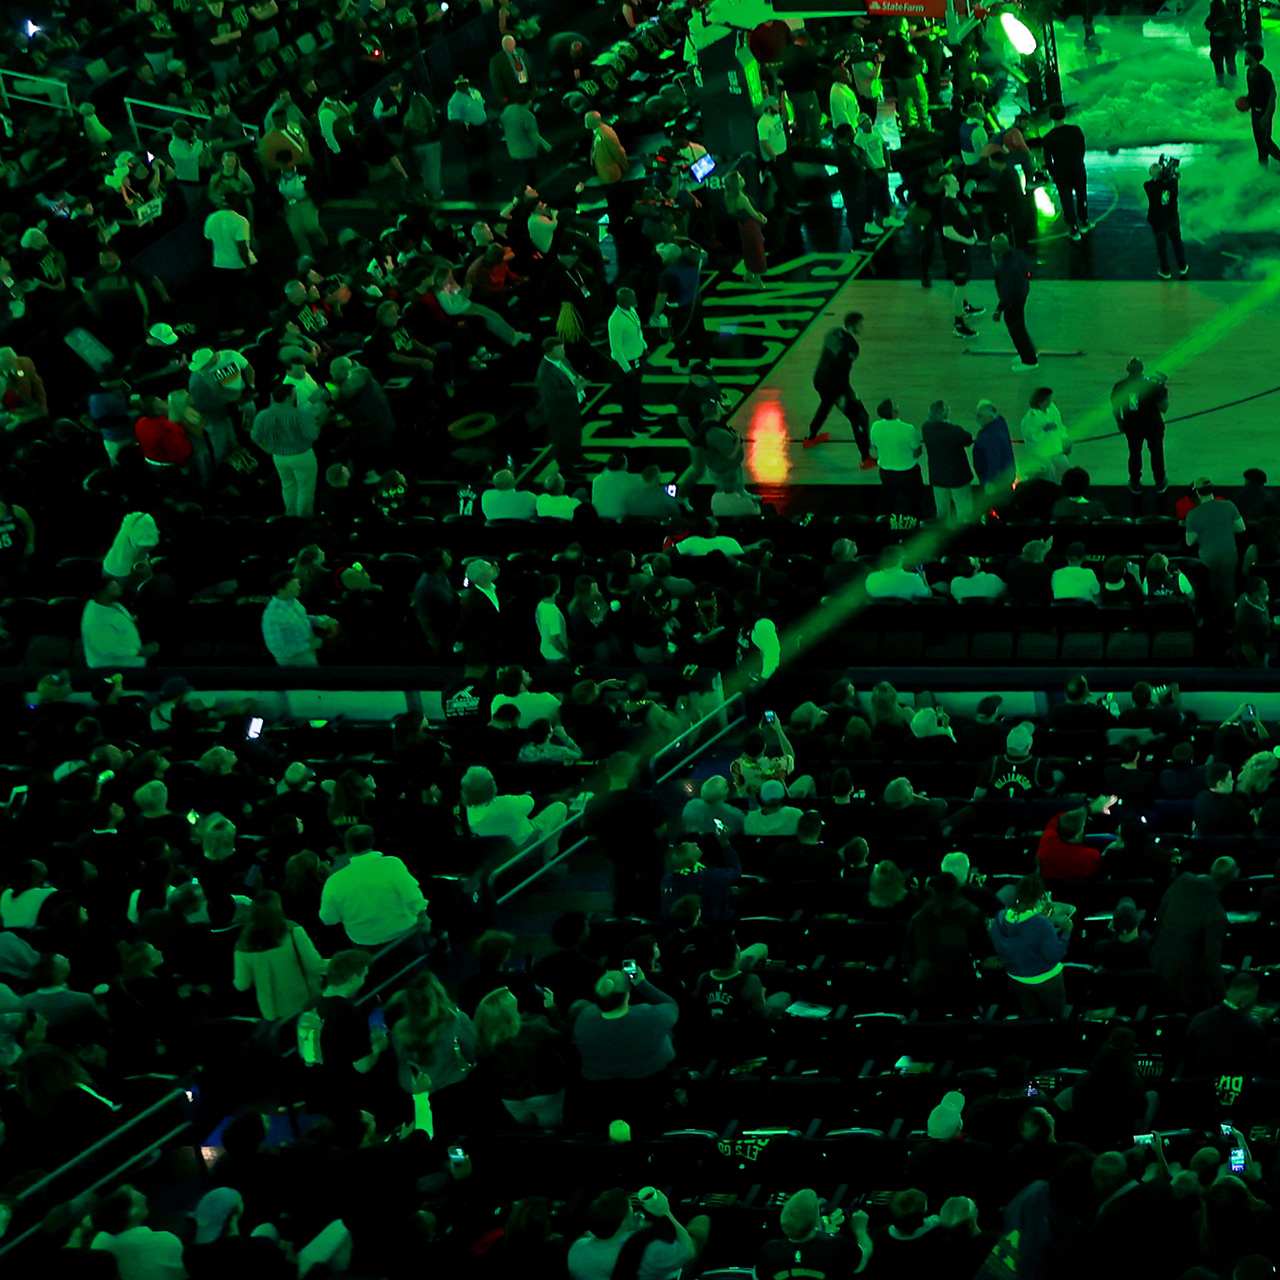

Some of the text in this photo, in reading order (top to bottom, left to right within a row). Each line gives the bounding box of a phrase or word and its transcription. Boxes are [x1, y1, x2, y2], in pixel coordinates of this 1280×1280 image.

[994, 773, 1032, 790] WILLIAMSON
[1009, 786, 1015, 798] 1
[706, 991, 734, 1006] JONES
